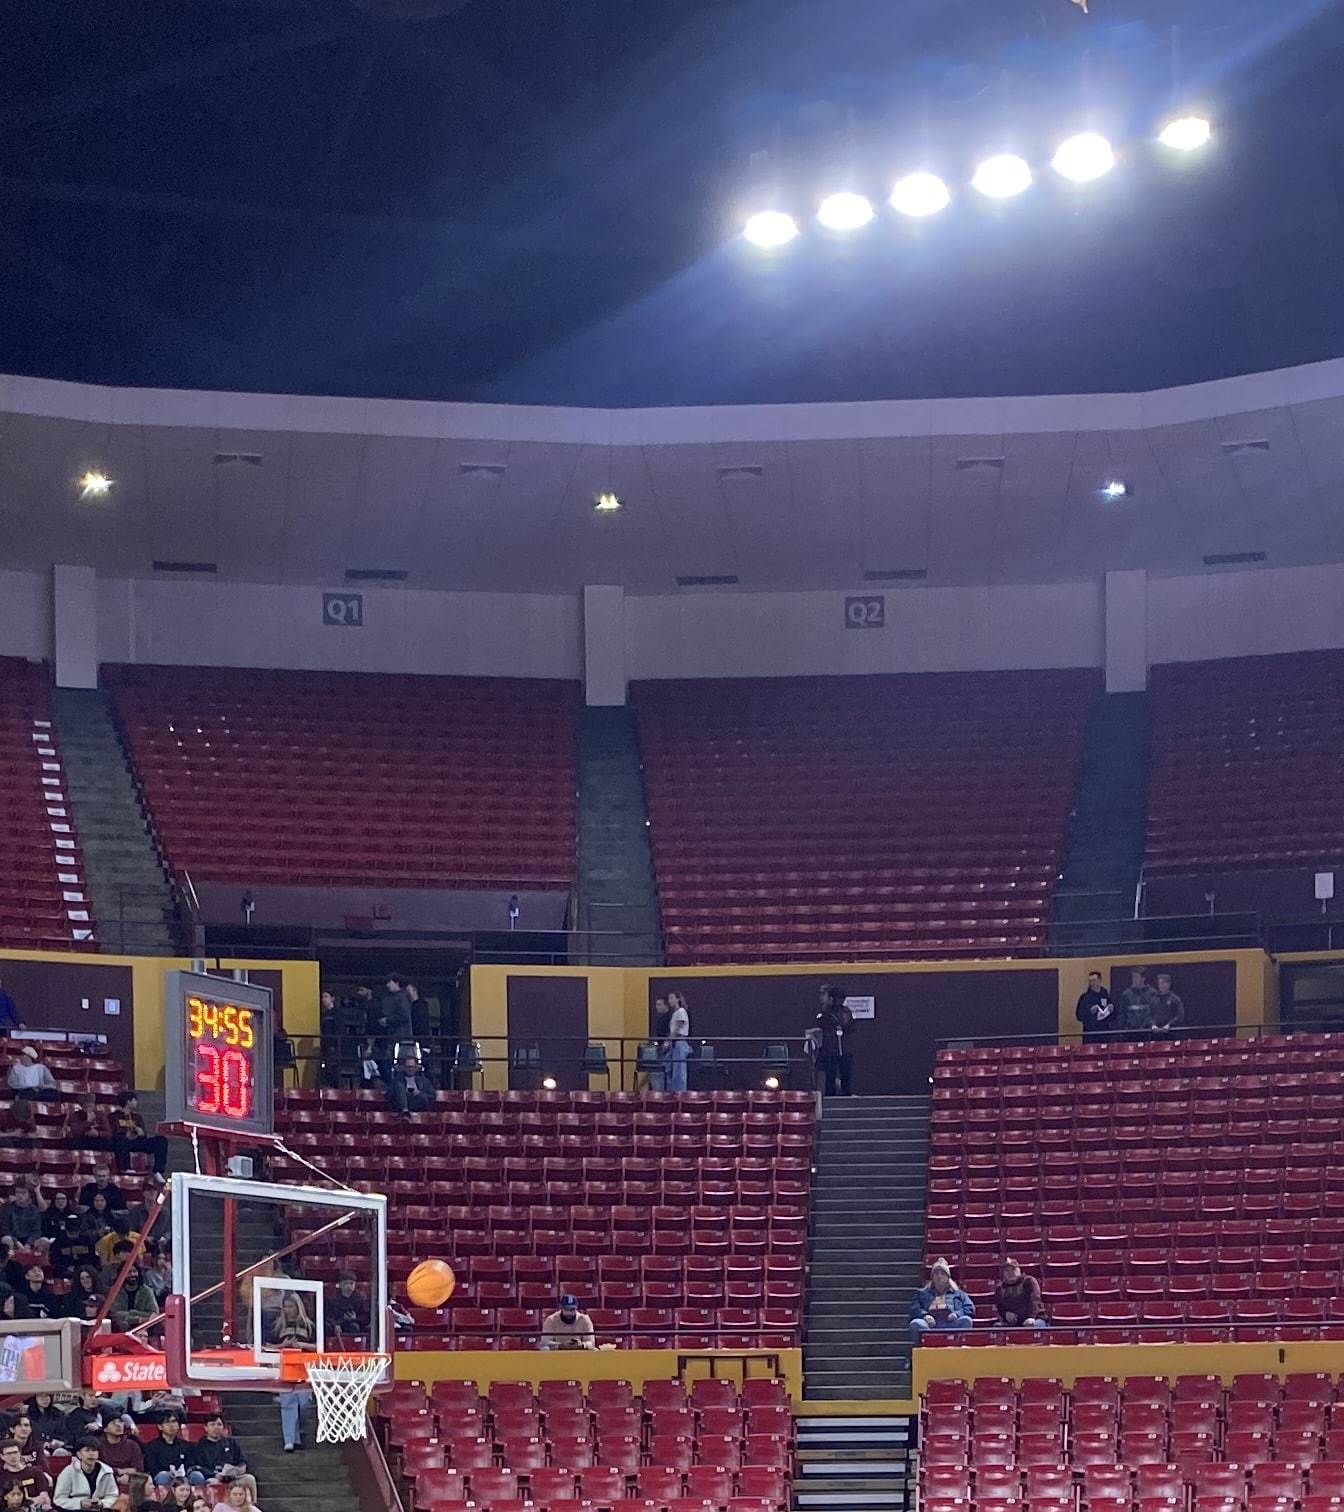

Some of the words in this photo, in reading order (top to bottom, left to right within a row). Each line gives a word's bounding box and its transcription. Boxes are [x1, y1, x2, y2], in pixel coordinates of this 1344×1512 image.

[328, 599, 359, 625] Q1
[848, 602, 881, 626] Q2
[189, 998, 254, 1048] 34:55
[197, 1044, 249, 1117] 30
